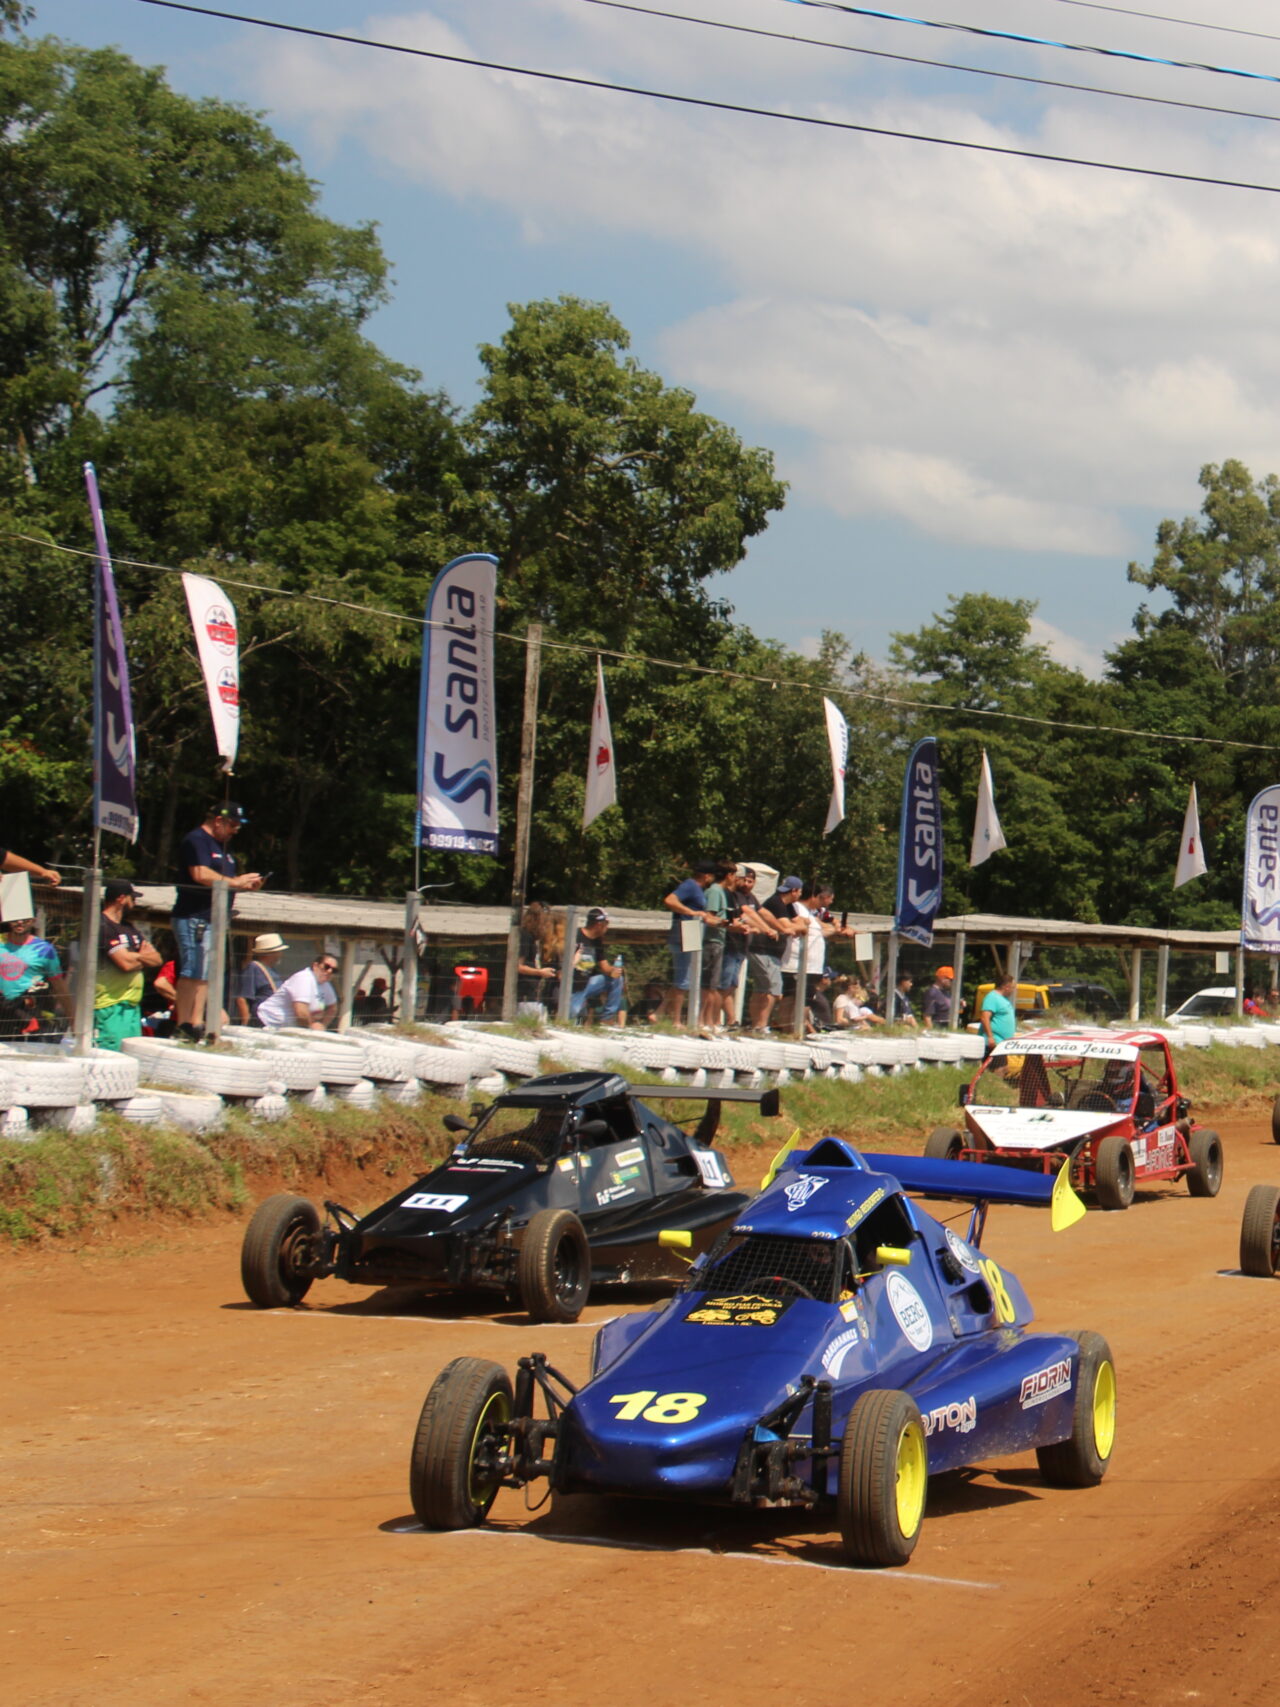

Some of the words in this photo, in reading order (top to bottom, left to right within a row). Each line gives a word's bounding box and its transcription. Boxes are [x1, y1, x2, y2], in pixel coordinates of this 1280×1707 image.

[444, 584, 479, 740] santa
[913, 761, 936, 871] santa
[1256, 804, 1279, 890] santa
[1080, 1043, 1122, 1056] Jesus
[900, 1301, 924, 1328] BERG
[978, 1259, 1015, 1323] 18
[608, 1390, 708, 1424] 18
